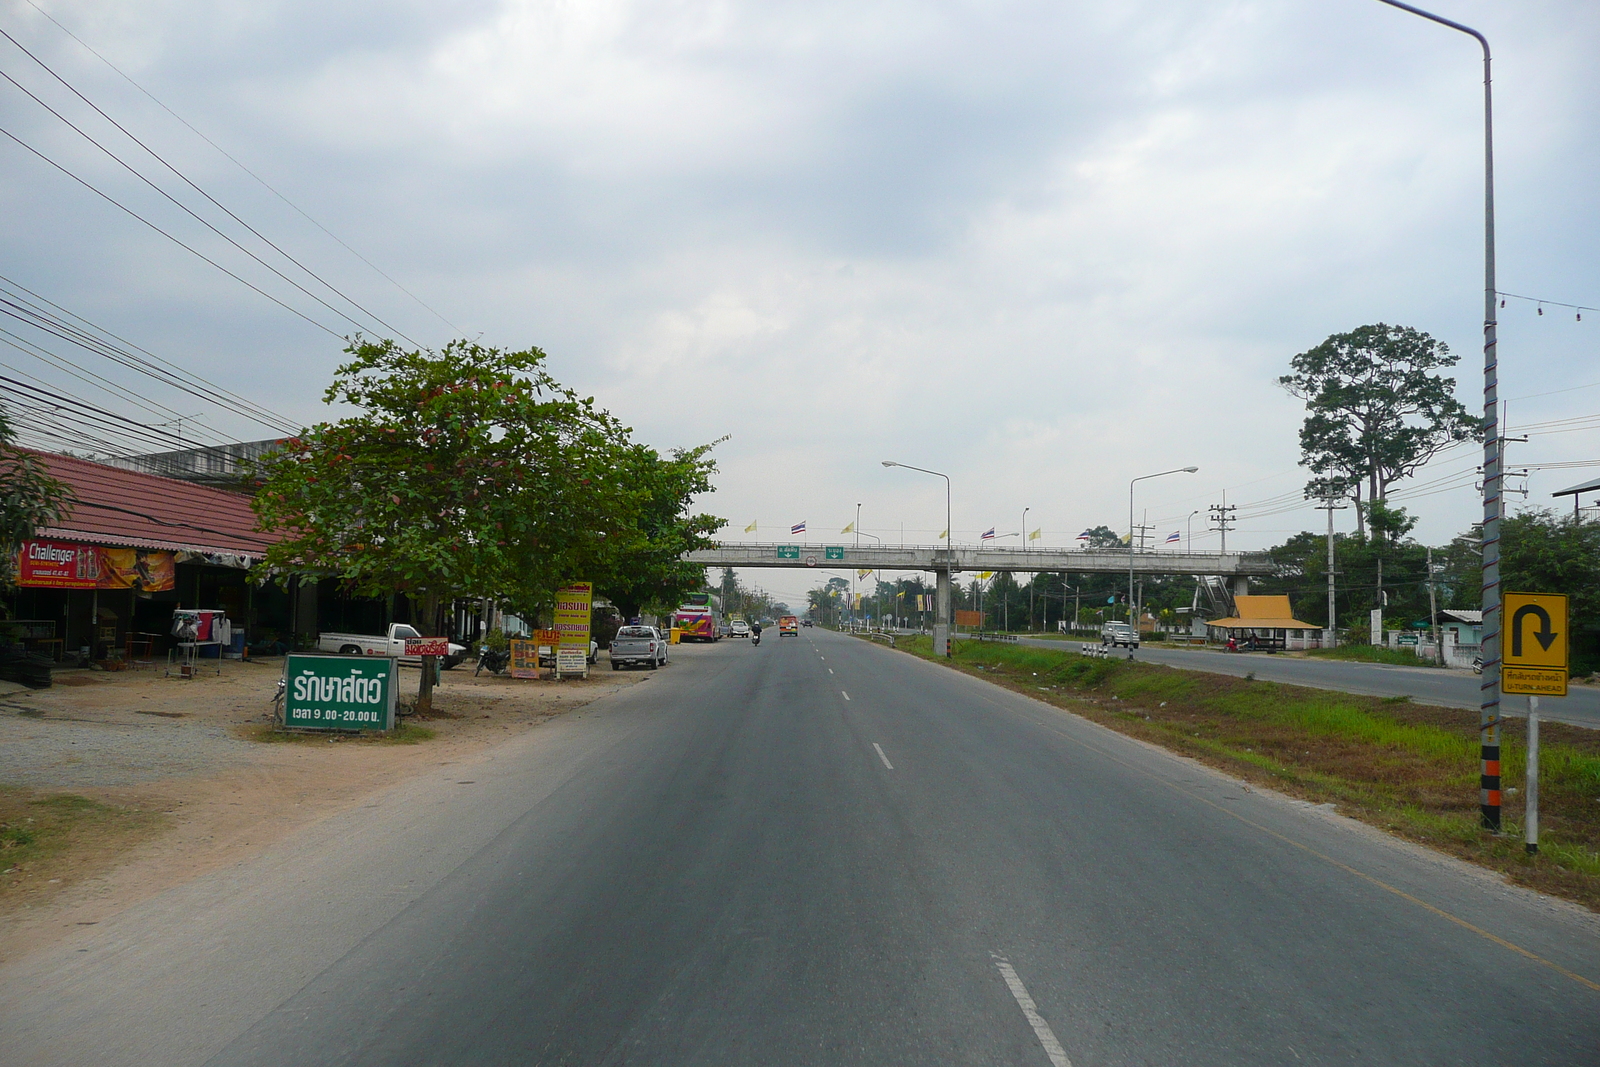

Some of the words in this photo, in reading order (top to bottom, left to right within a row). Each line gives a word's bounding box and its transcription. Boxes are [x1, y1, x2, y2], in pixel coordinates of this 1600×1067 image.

[29, 542, 75, 565] Challenger
[1507, 670, 1562, 681] ที่กลับรถข้างหน้า
[293, 668, 386, 704] รักษาสัตว์
[293, 708, 311, 719] เวลา
